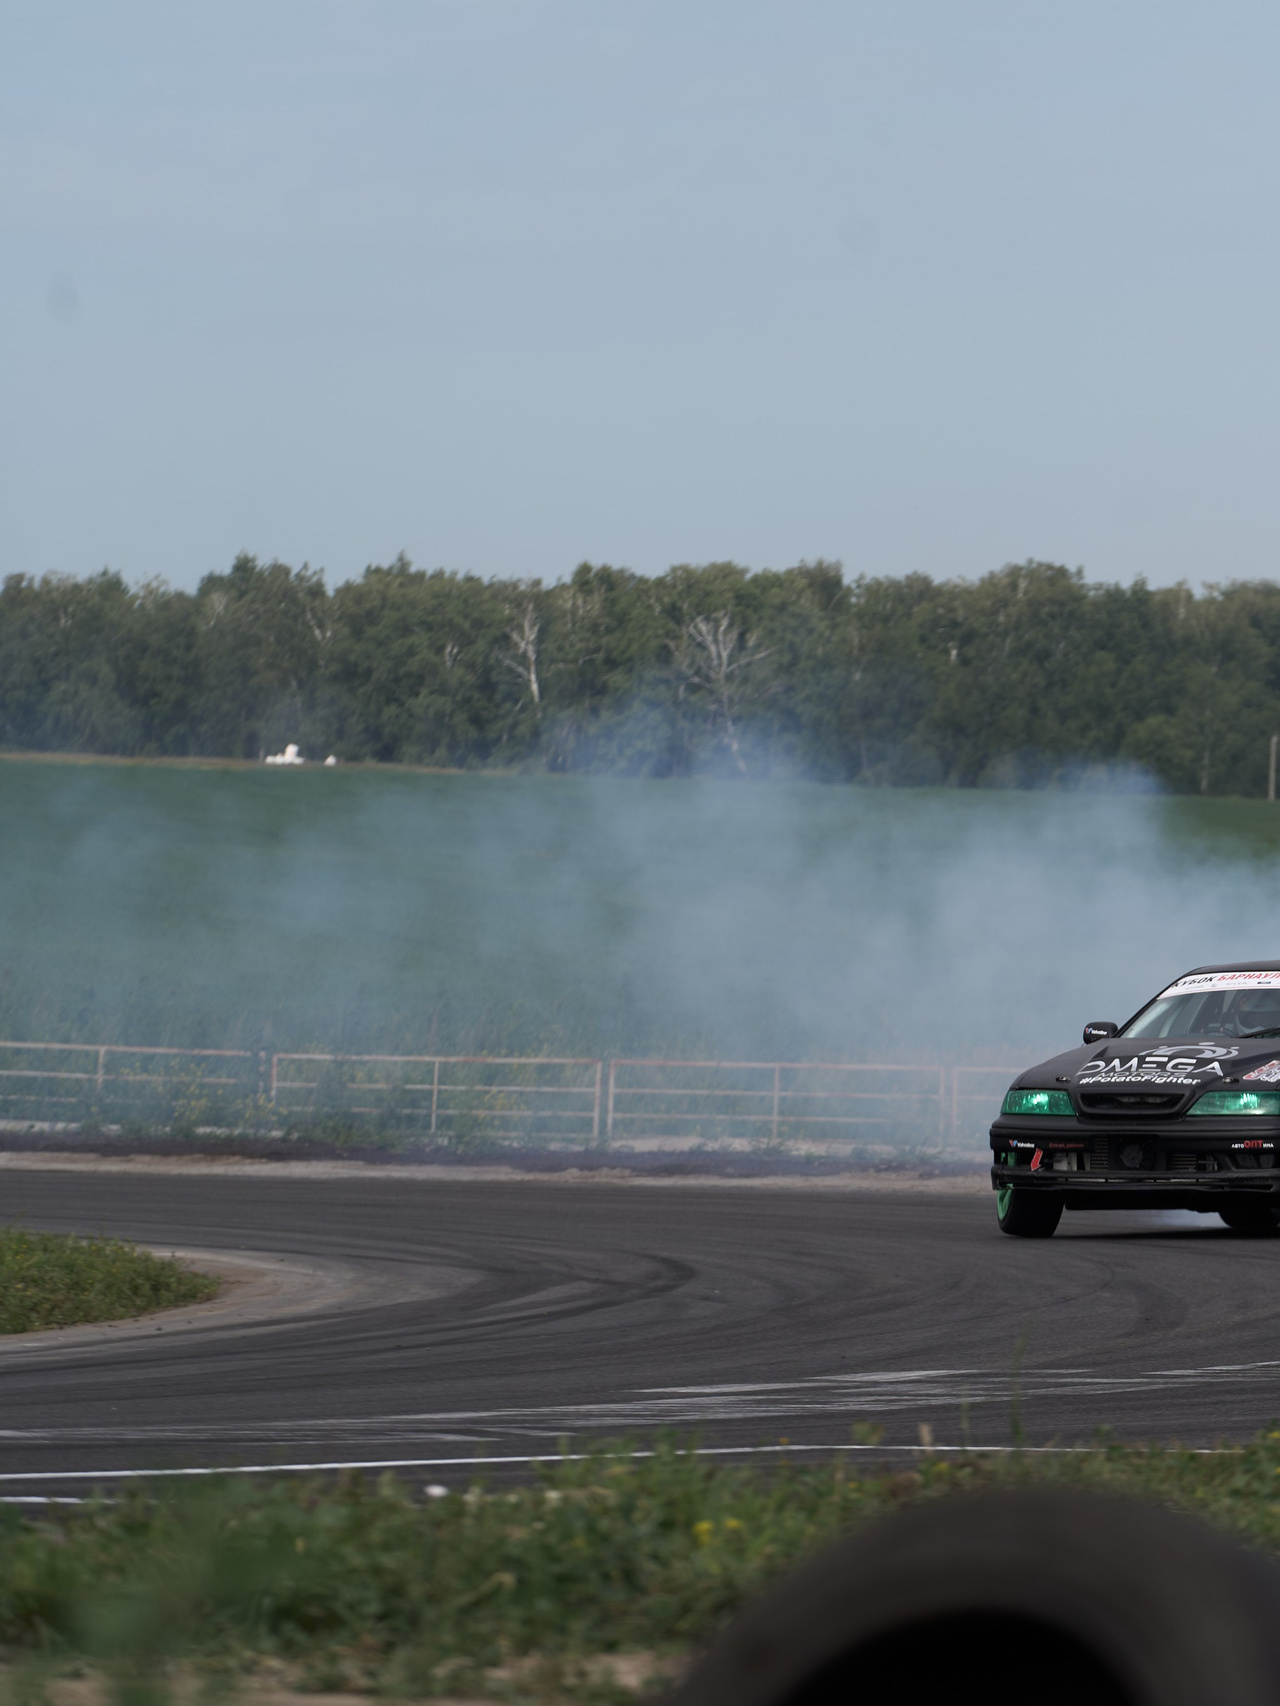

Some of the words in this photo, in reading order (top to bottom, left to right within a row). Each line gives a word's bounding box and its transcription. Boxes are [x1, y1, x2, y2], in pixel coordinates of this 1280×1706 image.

[1171, 976, 1217, 988] КУБОК
[1076, 1056, 1224, 1077] OMEGA
[1079, 1074, 1201, 1085] #PotatoFighter
